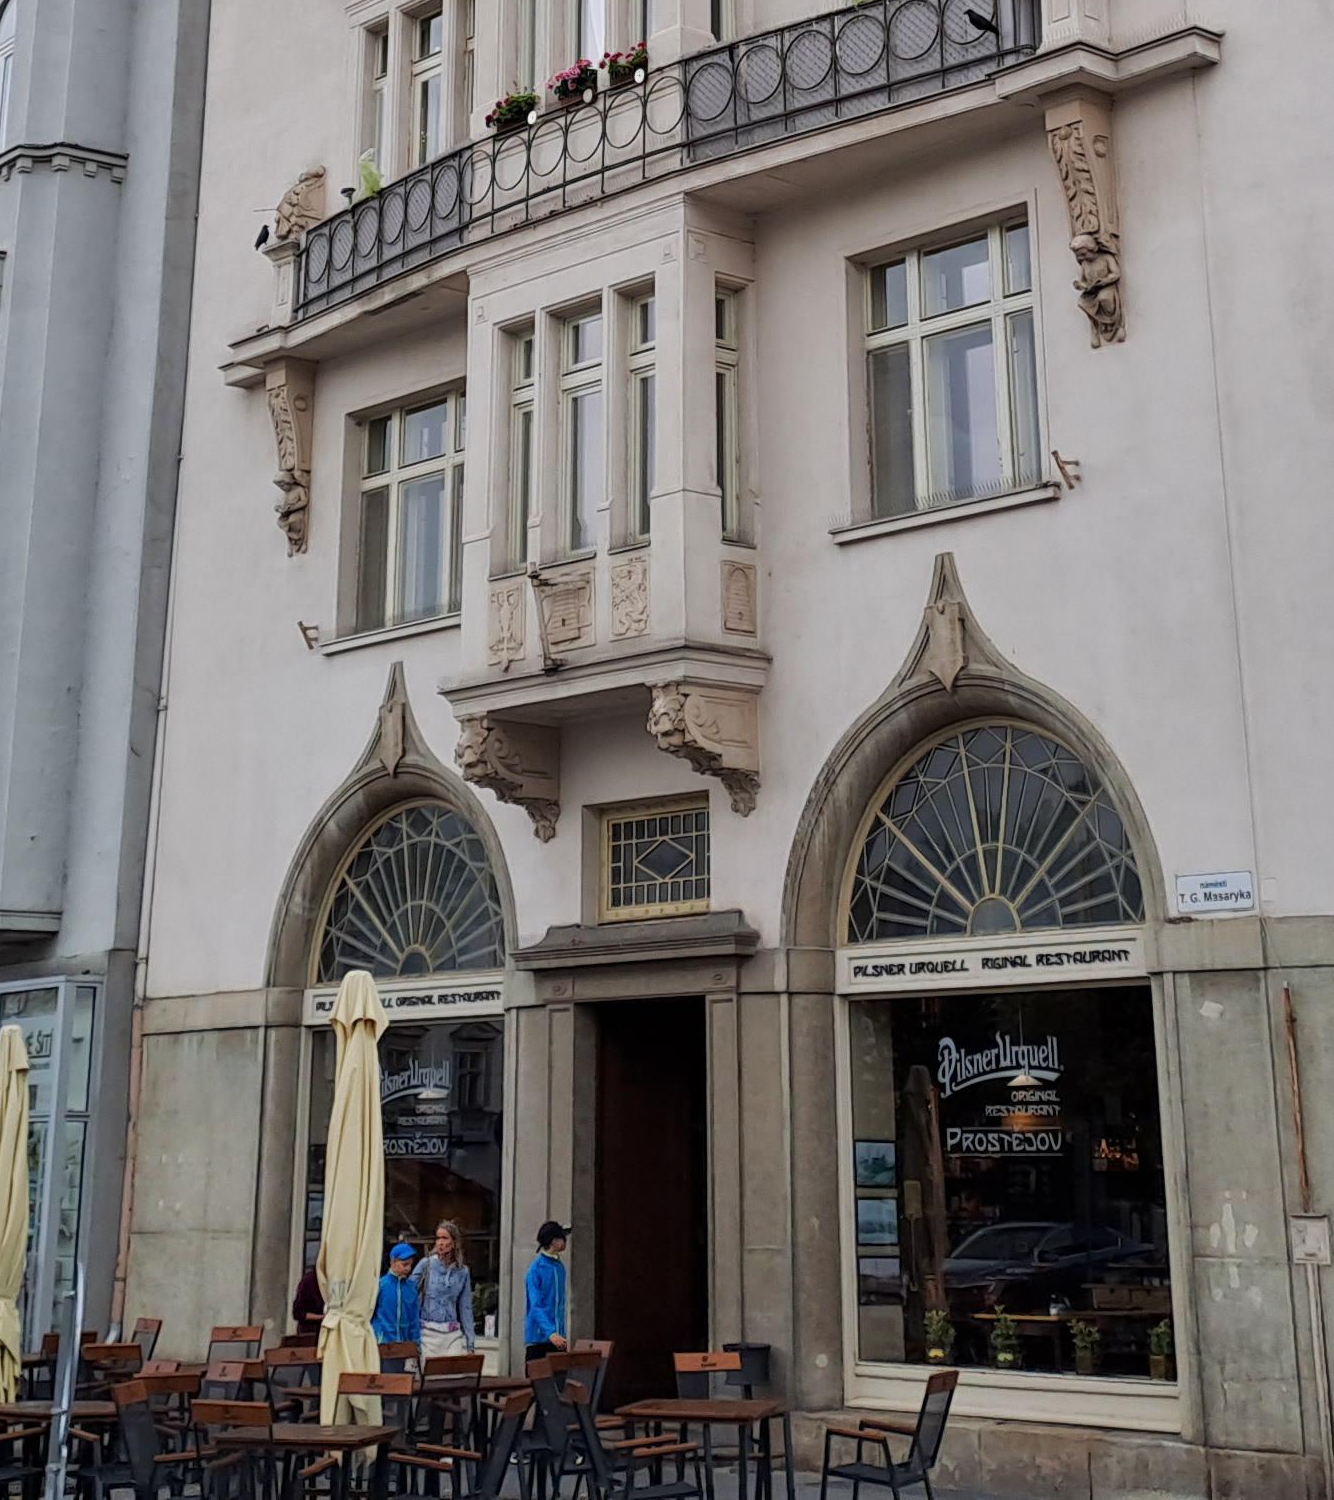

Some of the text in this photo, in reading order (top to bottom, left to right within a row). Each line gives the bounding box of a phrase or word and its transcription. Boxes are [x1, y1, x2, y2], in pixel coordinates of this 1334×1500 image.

[1179, 889, 1251, 903] T. G. Masaryka
[853, 963, 905, 978] PILSNER
[909, 959, 969, 976] URQUELL
[1035, 950, 1131, 967] RESTAURANT
[1011, 1090, 1061, 1103] ORIGINAL
[985, 1104, 1061, 1117] RESTAURANT
[384, 1131, 449, 1153] ROSTĚJOV
